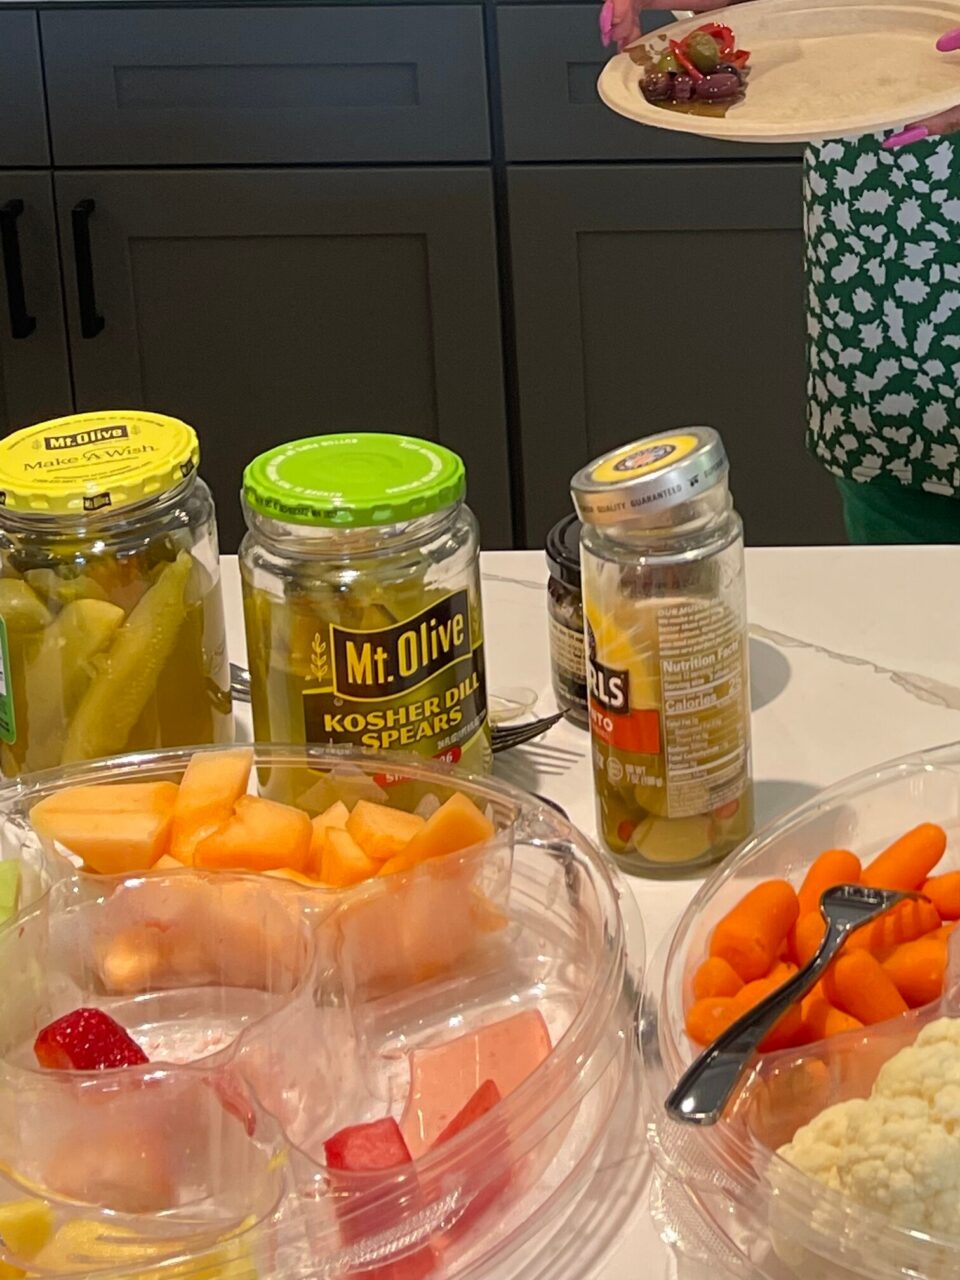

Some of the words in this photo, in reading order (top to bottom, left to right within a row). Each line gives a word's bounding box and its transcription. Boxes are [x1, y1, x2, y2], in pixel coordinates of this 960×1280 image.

[345, 640, 394, 685] Mt.
[397, 613, 464, 678] Olive
[663, 648, 715, 673] Nutrition
[323, 697, 440, 732] KOSHER
[445, 672, 480, 709] DILL
[665, 693, 717, 713] Calories
[361, 706, 463, 753] SPEARS
